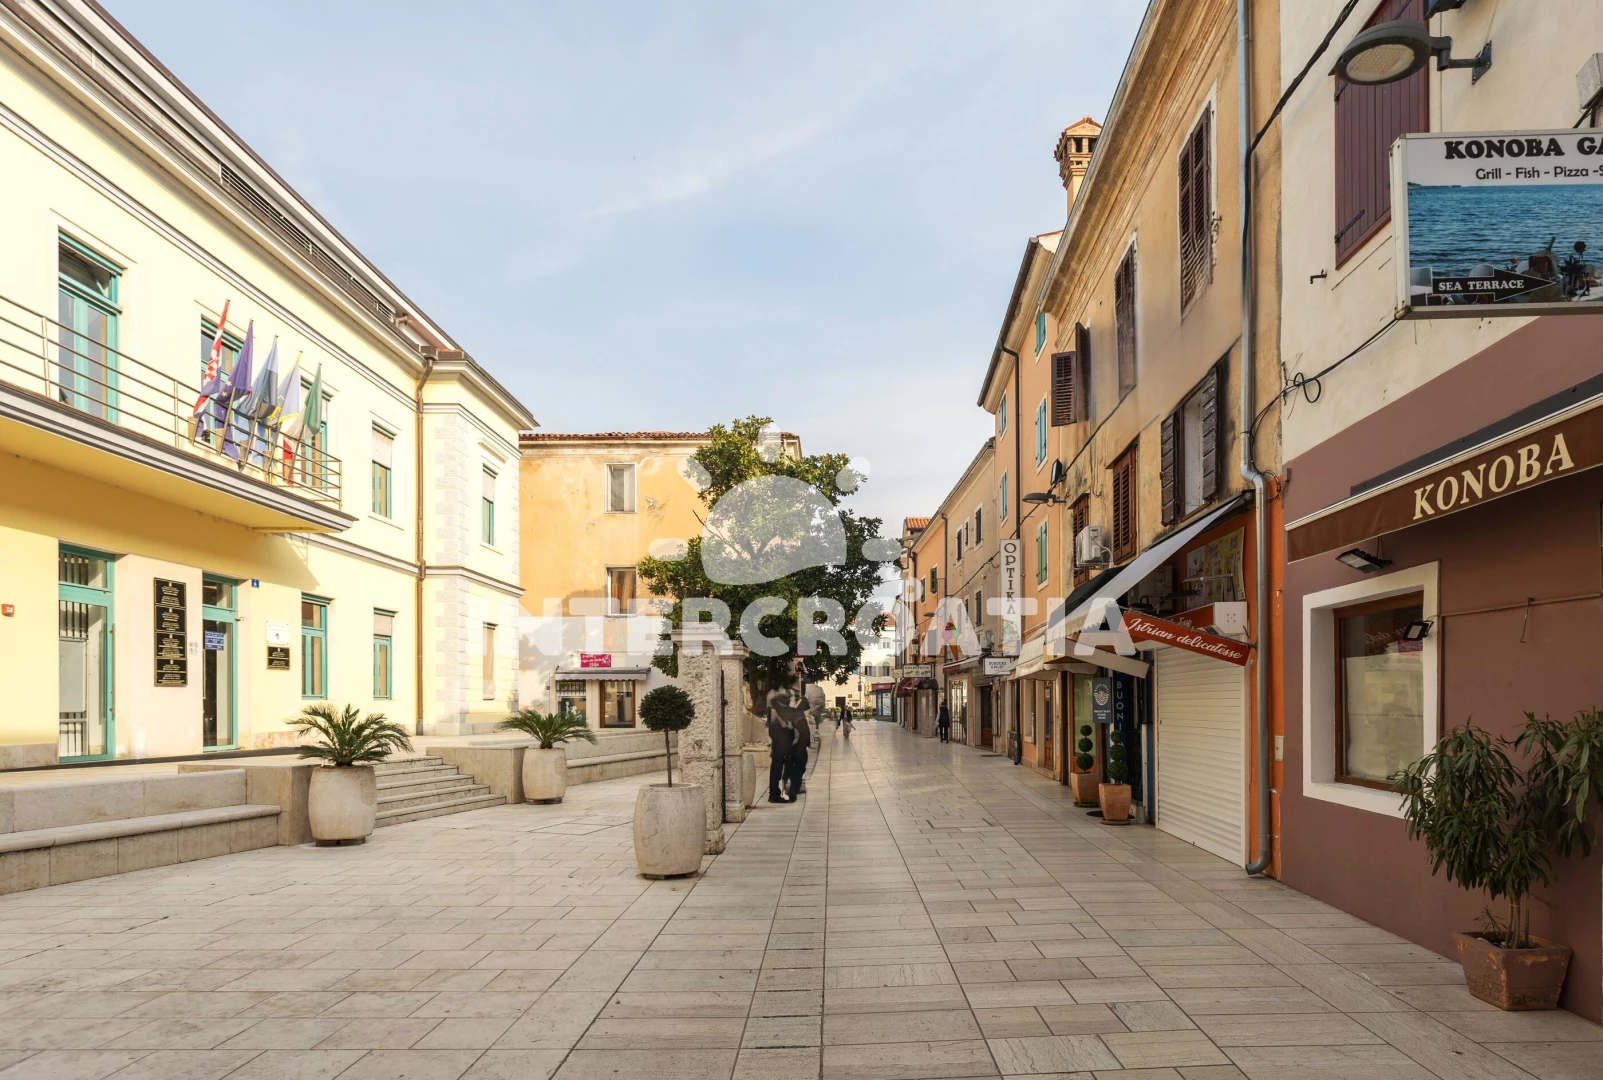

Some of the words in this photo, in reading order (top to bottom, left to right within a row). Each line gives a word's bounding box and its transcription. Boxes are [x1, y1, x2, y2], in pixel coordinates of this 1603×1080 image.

[1444, 138, 1565, 160] KONOBA
[1475, 168, 1502, 180] Grill
[1515, 167, 1540, 179] Fish
[1554, 166, 1589, 178] Pizza
[1438, 282, 1463, 291] SEA
[1467, 280, 1525, 290] TERRACE
[1412, 432, 1575, 521] KONOBA
[1003, 542, 1017, 615] OPTIKA
[1126, 618, 1176, 640] Istrian
[1176, 635, 1243, 659] delicatesse
